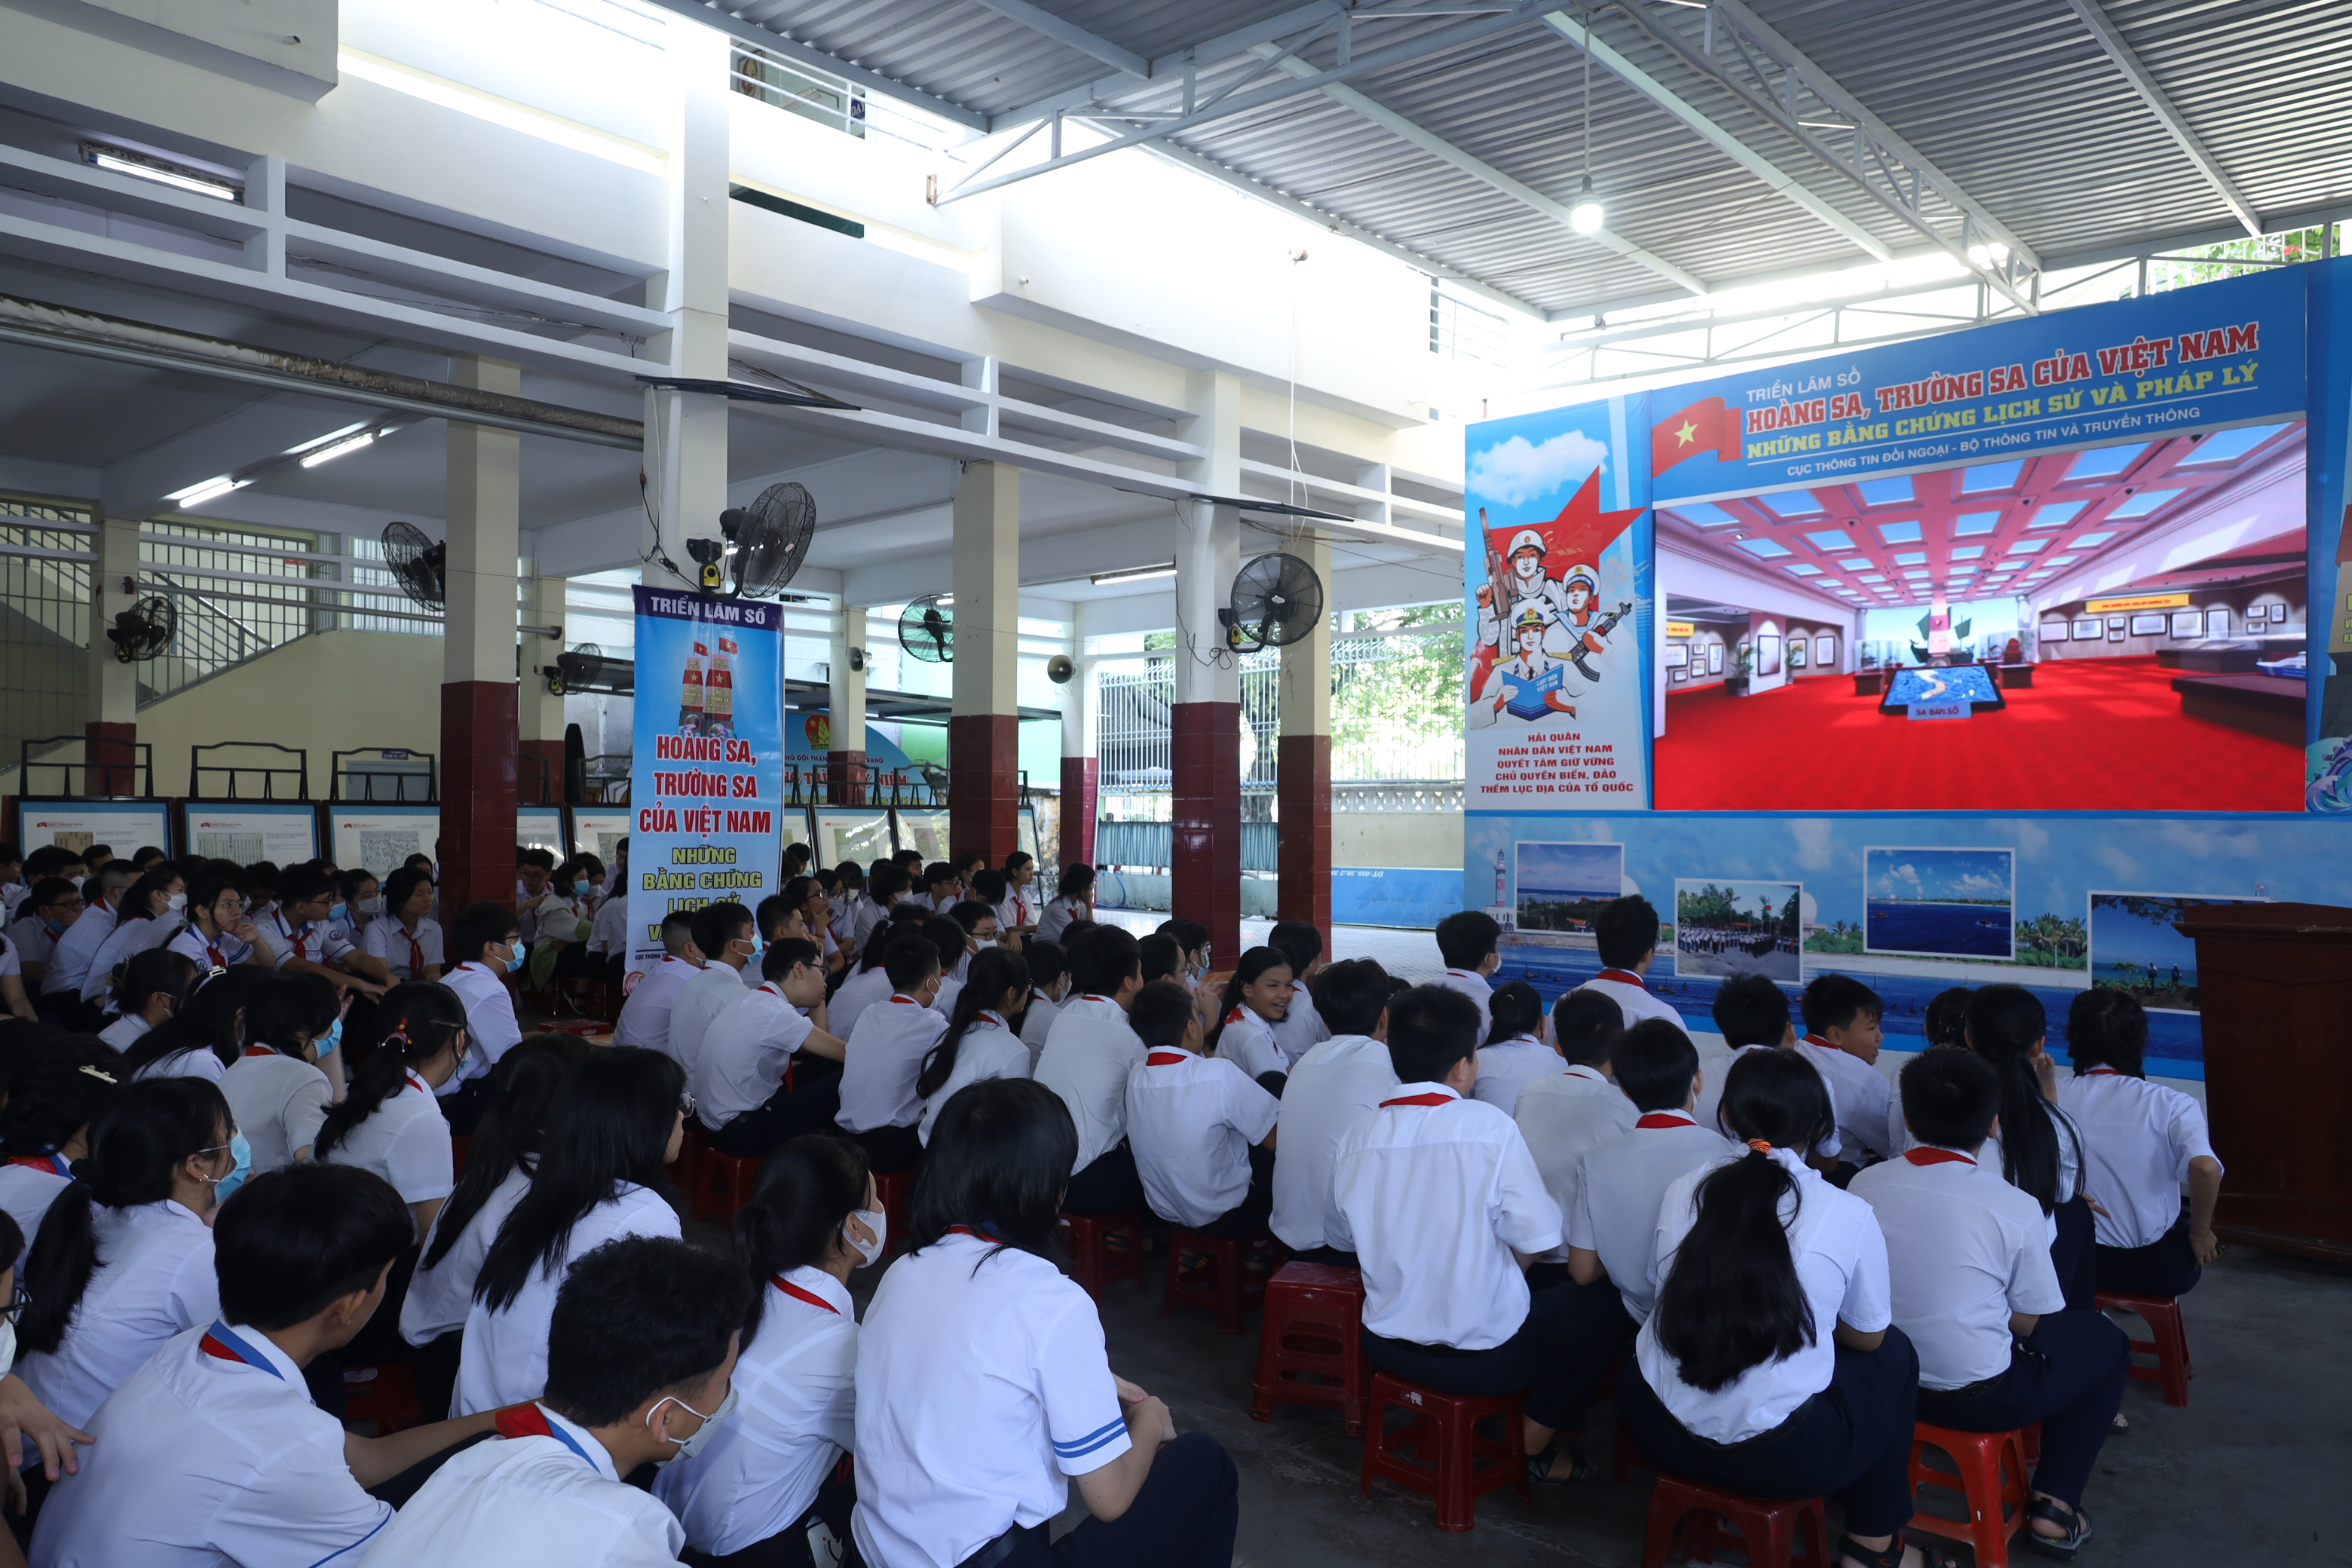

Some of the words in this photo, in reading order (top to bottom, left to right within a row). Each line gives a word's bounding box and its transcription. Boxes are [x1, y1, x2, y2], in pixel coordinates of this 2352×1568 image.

[1747, 399, 1827, 434] HOÀNG
[1830, 391, 1872, 421] SA,
[1876, 371, 1983, 413] TRƯỜNG
[1989, 363, 2027, 395] SA
[2033, 348, 2092, 387] CỦA
[2097, 335, 2173, 378] VIỆT
[2178, 320, 2259, 364] NAM
[1747, 379, 1793, 403] TRIỂN
[1798, 374, 1832, 394] LÃM
[1837, 365, 1861, 387] SỐ
[1747, 433, 1821, 459] NHỮNG
[1827, 421, 1889, 447] BẰNG
[1895, 409, 1976, 436] CHỨNG
[1983, 398, 2041, 425] LỊCH
[2048, 387, 2084, 413] SỬ
[2090, 381, 2127, 406] VÀ
[2136, 369, 2214, 400] PHÁP
[2222, 358, 2259, 386] LÝ
[1787, 463, 1812, 477] CỤC
[1815, 456, 1857, 473] THÔNG
[1860, 454, 1880, 467] TIN
[1882, 446, 1905, 462] ĐỐI
[1908, 444, 1949, 460] NGOẠI
[1960, 438, 1980, 452] BỘ
[1983, 432, 2032, 449] THÔNG
[2035, 428, 2057, 442] TIN
[2060, 422, 2080, 438] VÀ
[2083, 412, 2142, 434] TRUYỀN
[2145, 406, 2201, 424] THÔNG
[651, 594, 700, 617] TRIỂN
[704, 602, 740, 622] LÃM
[744, 606, 767, 625] SỐ
[656, 732, 722, 762] HOÀNG
[725, 739, 758, 767] SA,
[1499, 746, 1528, 755] NHÂN
[1532, 746, 1554, 755] DÂN
[1558, 744, 1582, 755] VIỆT
[1585, 744, 1612, 753] NAM
[1528, 732, 1545, 743] HẢI
[1550, 731, 1581, 743] QUÂN
[1496, 770, 1517, 781] CHỦ
[1521, 769, 1556, 780] QUYỀN
[1593, 768, 1616, 779] ĐẢO
[1497, 757, 1530, 768] QUYẾT
[1533, 756, 1557, 767] TÂM
[1560, 756, 1580, 767] GIỮ
[1583, 756, 1615, 766] VỮNG
[653, 767, 727, 798] TRƯỜNG
[732, 774, 758, 798] SA
[1513, 785, 1533, 794] LỤC
[1536, 784, 1554, 794] ĐỊA
[1558, 781, 1581, 792] CỦA
[1585, 781, 1599, 792] TỔ
[1603, 780, 1634, 792] QUỐC
[639, 801, 678, 834] CỦA
[683, 804, 722, 838] VIỆT
[727, 810, 771, 834] NAM
[672, 844, 737, 865] NHỮNG
[642, 867, 696, 890] BẰNG
[699, 869, 763, 889] CHỨNG
